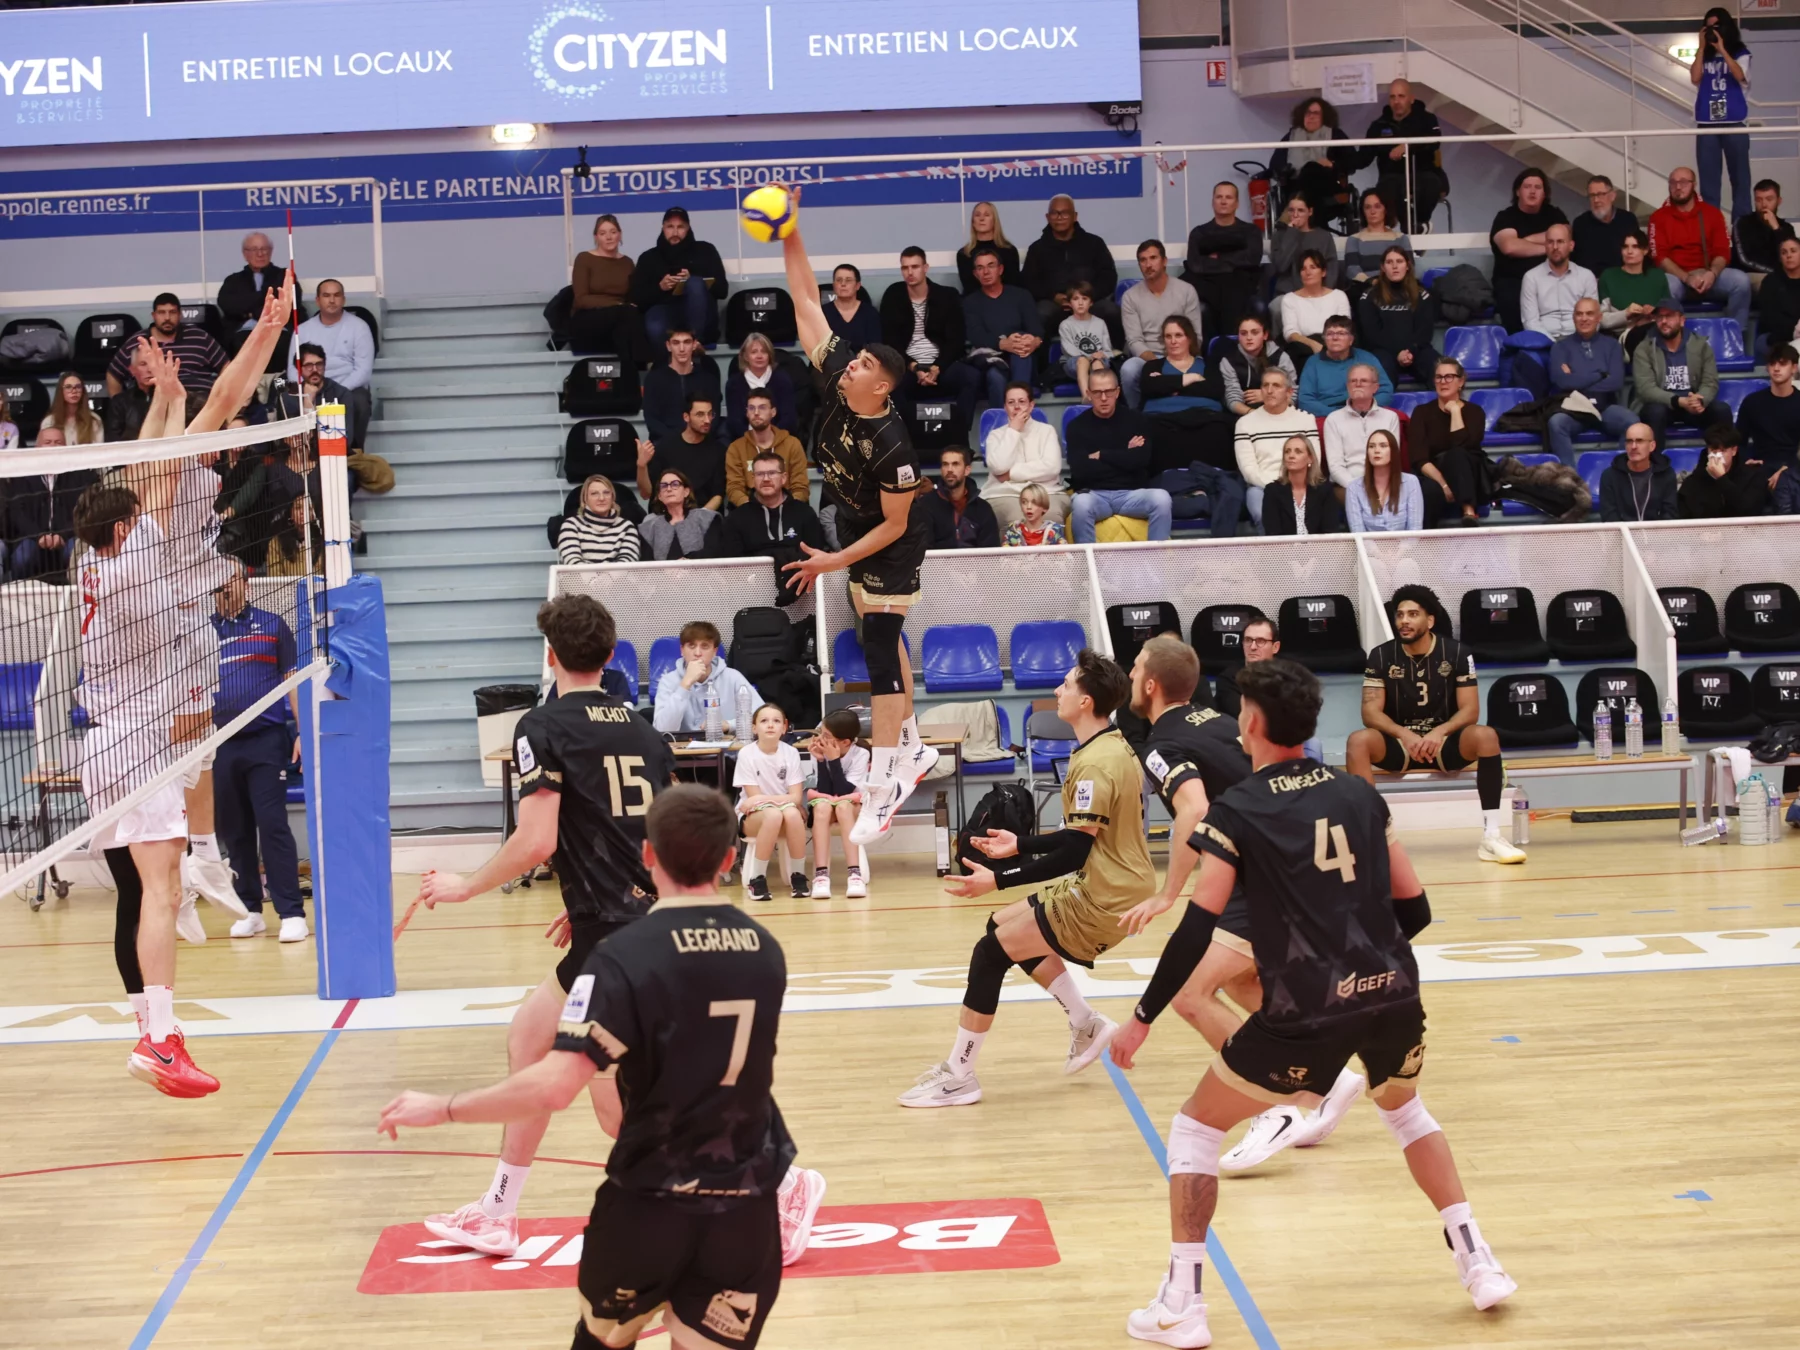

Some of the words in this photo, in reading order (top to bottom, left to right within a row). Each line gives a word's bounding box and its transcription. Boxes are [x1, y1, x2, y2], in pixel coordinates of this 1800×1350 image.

[808, 30, 948, 57] ENTRETIEN
[959, 26, 1078, 52] LOCAUX
[553, 28, 728, 73] CITYZEN
[182, 55, 322, 83] ENTRETIEN
[333, 49, 453, 76] LOCAUX
[0, 56, 103, 96] YZEN
[1108, 105, 1141, 115] Bodet
[246, 184, 345, 207] RENNES,
[435, 174, 575, 199] PARTENAIR
[581, 173, 611, 192] DE
[616, 170, 677, 192] TOUS
[683, 168, 721, 189] LES
[727, 166, 812, 188] SPORTS
[752, 297, 770, 306] VIP
[182, 309, 199, 318] VIP
[99, 324, 117, 333] VIP
[596, 365, 613, 374] VIP
[7, 387, 25, 397] VIP
[924, 407, 943, 416] VIP
[593, 429, 612, 438] VIP
[1489, 594, 1508, 604] VIP
[1668, 598, 1688, 608] VIP
[1752, 594, 1772, 604] VIP
[1306, 602, 1327, 612] VIP
[1574, 602, 1593, 612] VIP
[1131, 611, 1151, 620] VIP
[1220, 616, 1240, 626] VIP
[1778, 671, 1798, 681] VIP
[1608, 680, 1628, 691] VIP
[1701, 678, 1721, 688] VIP
[1416, 682, 1429, 706] 3
[1517, 684, 1537, 695] VIP
[585, 705, 631, 723] MICHOT
[1268, 766, 1335, 794] FONSECA
[603, 755, 654, 817] 15
[1314, 817, 1356, 883] 4
[671, 928, 761, 953] LEGRAND
[1357, 970, 1397, 993] GEFF
[709, 999, 756, 1087] 7
[499, 1173, 509, 1196] CRAFT
